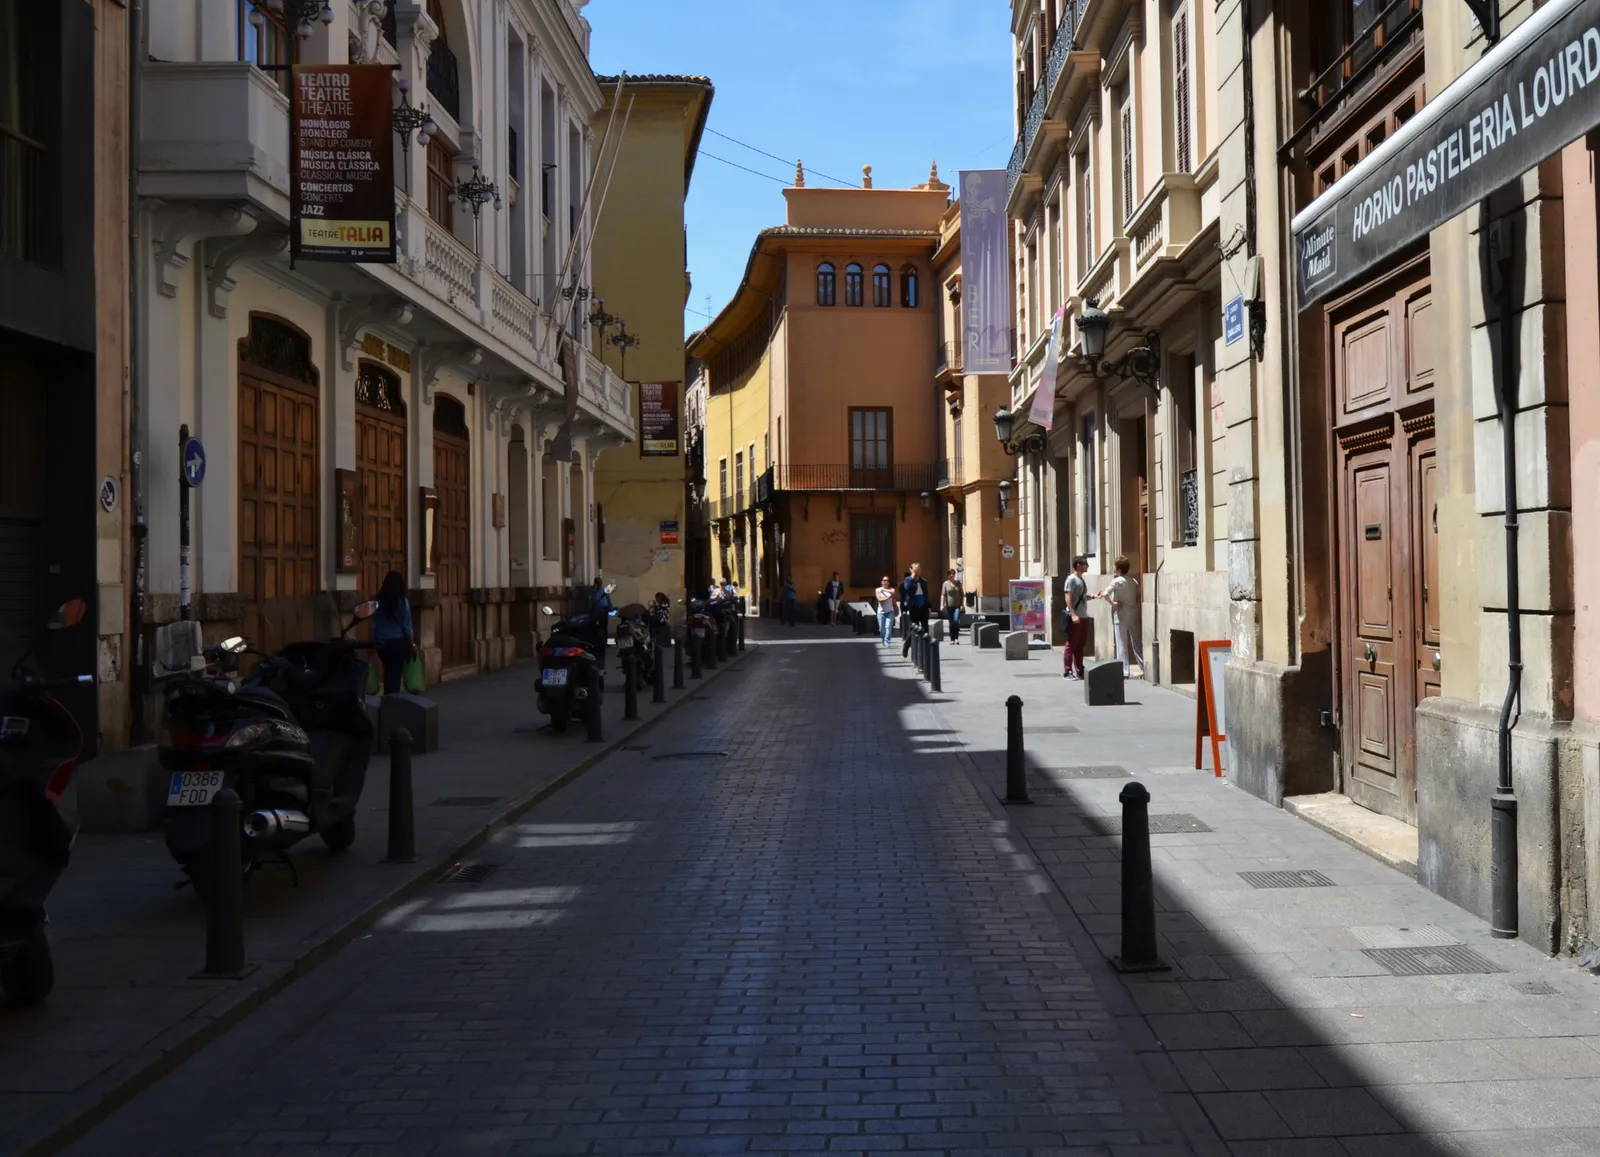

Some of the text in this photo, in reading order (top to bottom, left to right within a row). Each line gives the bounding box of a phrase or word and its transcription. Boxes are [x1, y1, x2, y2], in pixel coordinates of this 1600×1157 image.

[300, 73, 350, 87] TEATRO
[300, 87, 350, 101] TEATRE
[300, 101, 354, 116] THEATRE
[300, 118, 351, 129] MONÓLOGOS
[1352, 27, 1600, 242] HORNO PASTELERIA LOURD
[300, 138, 373, 148] STAND UP COMEDY
[300, 148, 372, 160] MÚSICA CLÁSICA
[300, 170, 373, 181] CLASSICAL MUSIC
[300, 182, 354, 193] CONCIERTOS
[300, 192, 344, 203] CONCERTS
[300, 204, 325, 216] JAZZ
[308, 226, 383, 242] TEATRE TALIA
[1305, 226, 1335, 259] Minute
[1307, 245, 1331, 279] Maid
[183, 772, 220, 787] 0386
[179, 789, 208, 804] FDD
